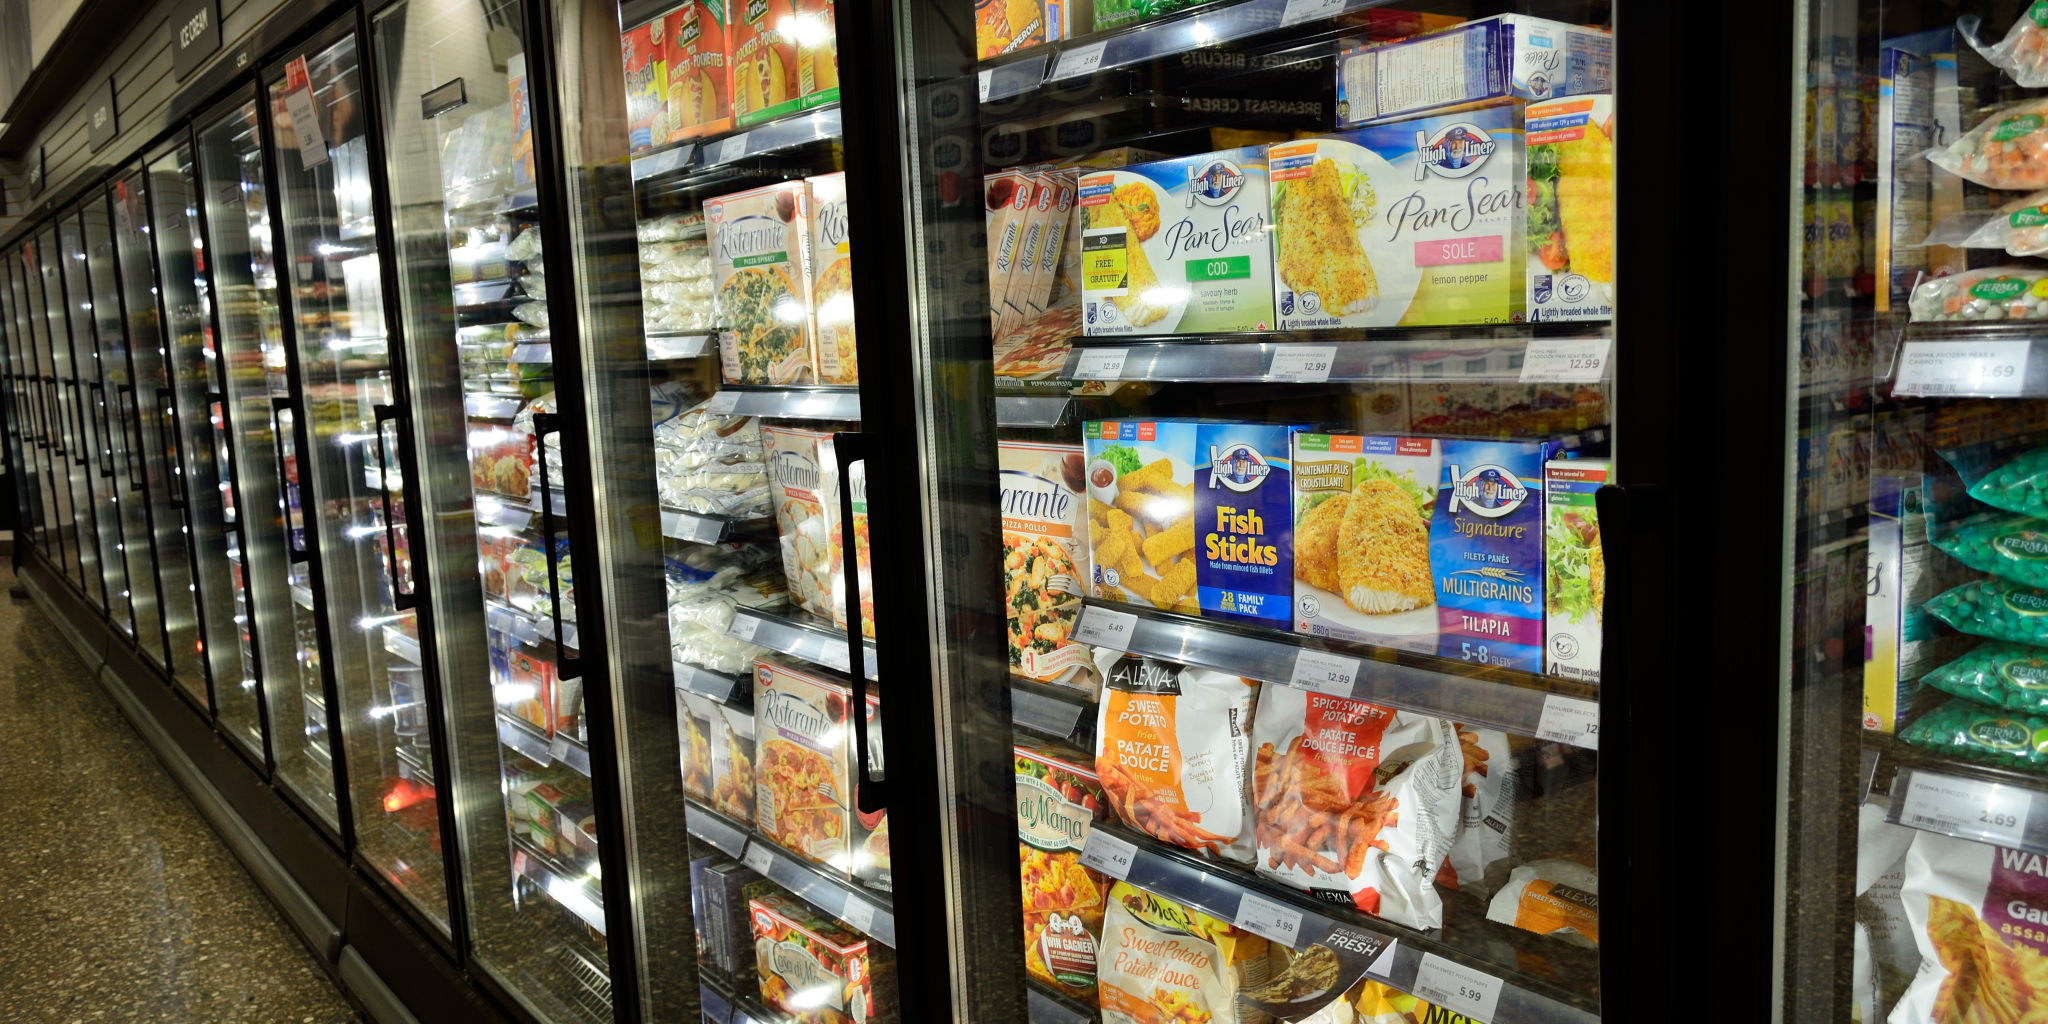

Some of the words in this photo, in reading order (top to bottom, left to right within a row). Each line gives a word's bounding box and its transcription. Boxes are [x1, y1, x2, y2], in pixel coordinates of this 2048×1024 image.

[180, 29, 190, 49] ICE
[189, 7, 208, 41] CREAM
[754, 25, 764, 33] PIZZA
[736, 36, 758, 64] POCKETS
[670, 59, 690, 83] POCKETS
[693, 52, 724, 67] POCHETTES
[1083, 55, 1099, 65] 2.69
[625, 54, 655, 95] Bagel
[631, 91, 658, 124] Bites
[1992, 118, 2034, 136] FERMA
[1421, 145, 1447, 165] High
[1464, 141, 1494, 157] Liner
[1190, 178, 1209, 195] High
[1222, 174, 1244, 188] Liner
[1387, 176, 1523, 243] Pan-Sear
[719, 219, 783, 260] Ristorante
[1165, 204, 1266, 261] Pan-Sear
[997, 221, 1018, 273] Ristorante
[1021, 223, 1041, 273] Ristorante
[1042, 222, 1061, 273] Ristorante
[1442, 242, 1476, 260] SOLE
[743, 257, 757, 265] PIZZA
[757, 256, 775, 264] SPINACI
[1095, 259, 1114, 268] FREE!
[1207, 261, 1228, 276] COD
[1090, 274, 1120, 283] GRATUIT!
[1432, 275, 1457, 285] lemon
[1459, 274, 1488, 286] pepper
[1200, 288, 1223, 298] savoury
[1224, 287, 1238, 296] herb
[1976, 283, 2020, 293] FERMA
[1531, 308, 1540, 322] 4
[1542, 307, 1559, 318] Lightly
[1560, 307, 1581, 316] breaded
[1583, 306, 1598, 315] whole
[1288, 318, 1301, 328] Lightly
[1301, 318, 1316, 326] breaded
[1317, 317, 1329, 325] whole
[1330, 317, 1341, 325] fillets
[1304, 362, 1327, 371] 12.99
[1569, 359, 1600, 369] 12.99
[771, 450, 820, 490] Ristorante
[1214, 460, 1233, 478] High
[1246, 462, 1268, 476] Liner
[1296, 464, 1333, 475] MAINTENANT
[1333, 464, 1349, 475] PLUS
[1300, 477, 1344, 488] CROUSTILLANT!
[1456, 482, 1480, 501] High
[1498, 484, 1526, 501] Liner
[1002, 519, 1022, 530] PIZZA
[1024, 522, 1047, 533] POLLO
[1217, 506, 1264, 536] Fish
[1454, 517, 1524, 539] Signature
[1205, 533, 1278, 567] Sticks
[2003, 537, 2048, 552] FERMA
[1463, 552, 1486, 562] FILETS
[1488, 553, 1510, 564] PANÉS
[1209, 561, 1221, 569] Made
[1222, 562, 1232, 570] from
[1233, 563, 1249, 572] minced
[1249, 565, 1258, 573] fish
[1259, 566, 1274, 575] fillets
[1221, 591, 1234, 603] 28
[1238, 593, 1264, 605] FAMILY
[1443, 577, 1532, 604] MULTIGRAINS
[1239, 604, 1258, 615] PACK
[1108, 623, 1124, 632] 6.49
[1462, 615, 1511, 637] TILAPIA
[1461, 642, 1488, 663] 5-8
[1491, 655, 1511, 668] FILETS
[1111, 665, 1173, 687] ALEXIA
[1327, 672, 1350, 684] 12.99
[1550, 662, 1559, 677] 4
[1561, 663, 1580, 674] Vacuum
[1581, 665, 1600, 678] packed
[763, 689, 831, 739] Ristorante
[1126, 699, 1161, 714] SWEET
[1312, 696, 1342, 710] SPICY
[1342, 700, 1388, 719] SWEET
[1547, 704, 1574, 713] HIGHLINER
[1574, 709, 1596, 717] SELECTS
[1118, 712, 1167, 728] POTATO
[1322, 710, 1365, 726] POTATO
[786, 731, 799, 742] PIZZA
[1136, 730, 1157, 740] fries
[1319, 728, 1356, 743] PATATE
[1978, 725, 2022, 741] FERMA
[1118, 739, 1170, 758] PATATE
[1185, 751, 1200, 763] Sweet
[1200, 749, 1213, 759] and
[1301, 738, 1337, 753] DOUCE
[1338, 743, 1376, 760] EPICÉ
[1119, 753, 1170, 773] DOUCE
[1133, 772, 1154, 783] frites
[1040, 782, 1053, 794] RISING
[1914, 783, 1939, 793] FERMA
[1941, 788, 1971, 799] FROZEN
[1914, 801, 1928, 809] 750
[1020, 796, 1034, 820] di
[1030, 794, 1084, 840] Mama
[1484, 817, 1506, 832] ALEXIA
[1979, 810, 2017, 828] 2.69
[1112, 854, 1127, 866] 4.49
[1315, 891, 1352, 904] ALEXIA
[1527, 890, 1549, 902] SWEET
[1548, 898, 1574, 912] POTATO
[1283, 911, 1298, 920] POTATO
[1275, 919, 1294, 932] 5.99
[1046, 936, 1062, 949] WIN
[1326, 933, 1378, 957] FRESH
[1334, 927, 1371, 944] FEATURED
[1372, 939, 1383, 947] IN
[1062, 938, 1094, 954] GAGNER
[1119, 927, 1165, 957] Sweet
[1162, 940, 1210, 969] Potato
[773, 942, 793, 976] Casa
[793, 961, 803, 978] di
[1113, 951, 1158, 980] Patate
[1156, 963, 1201, 990] douce
[1424, 962, 1440, 971] ALEXIA
[1440, 966, 1455, 976] SWEET
[1455, 973, 1474, 983] POTATO
[1474, 980, 1488, 989] PUFFS
[1459, 986, 1482, 1002] 5.99
